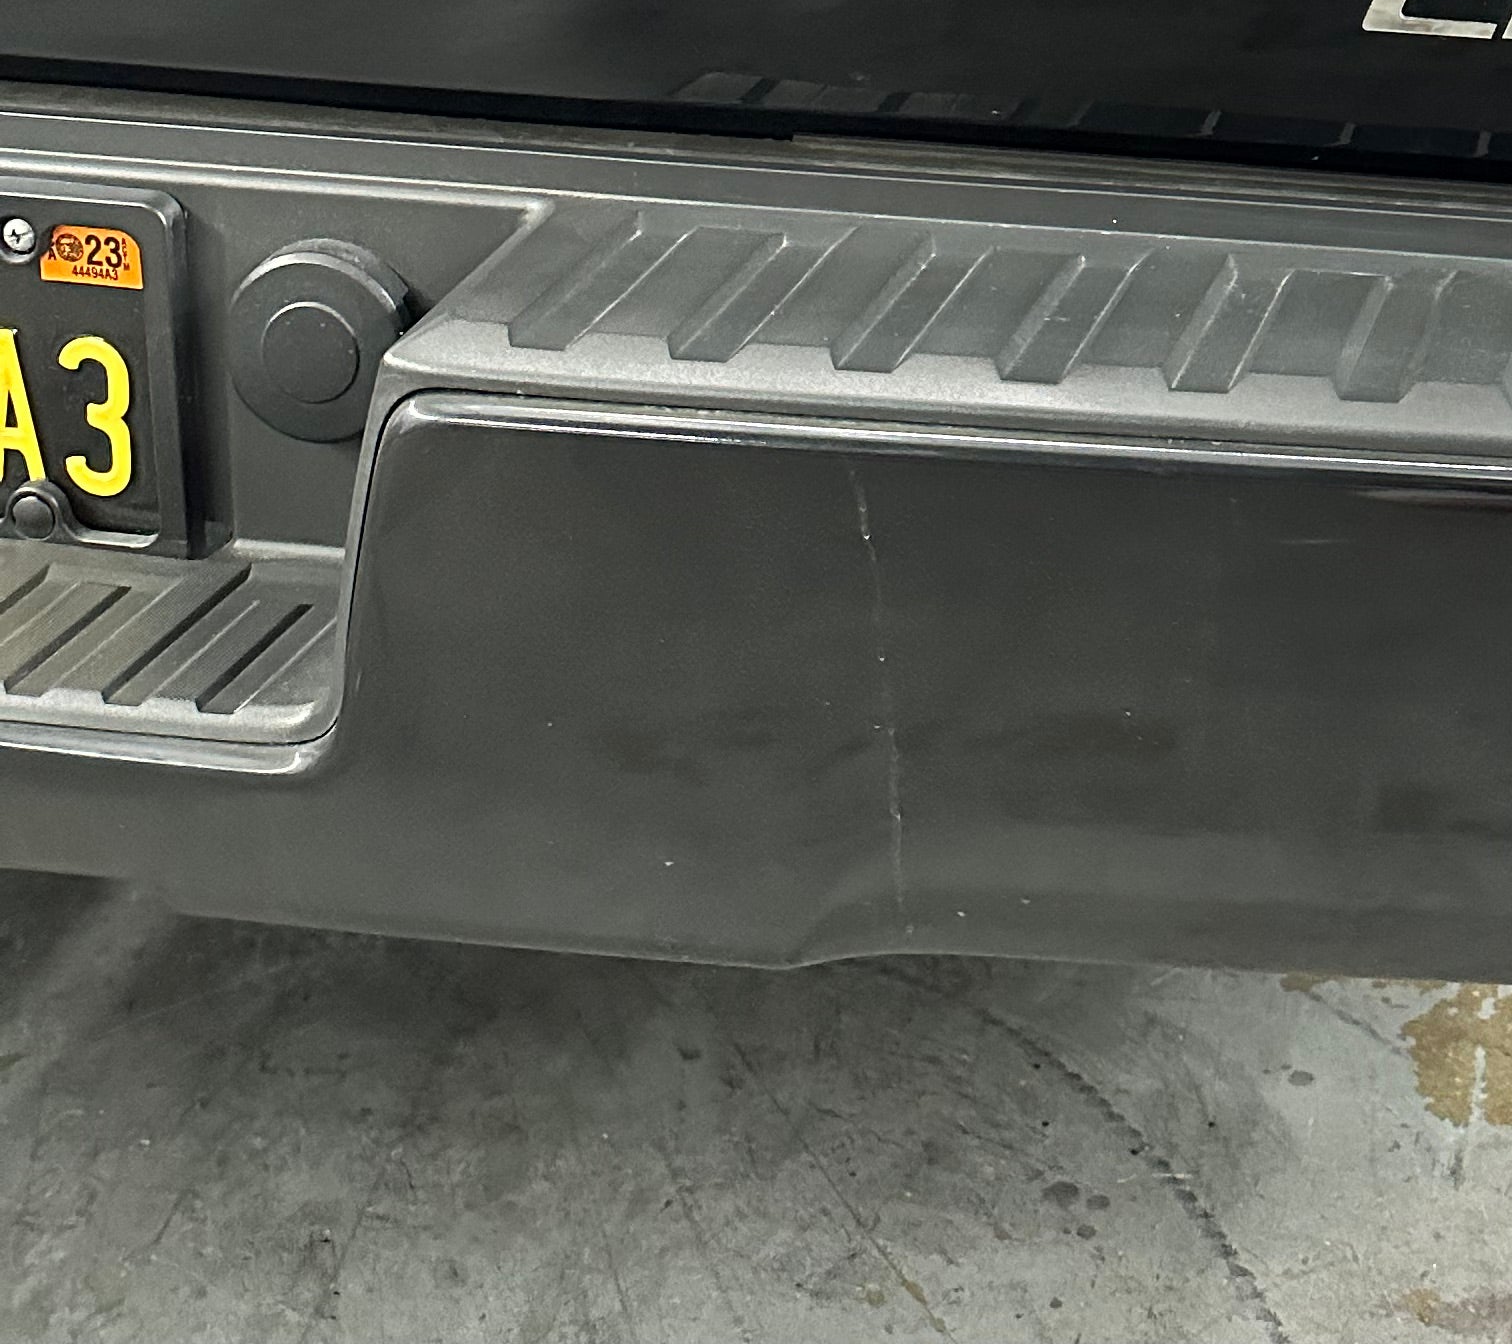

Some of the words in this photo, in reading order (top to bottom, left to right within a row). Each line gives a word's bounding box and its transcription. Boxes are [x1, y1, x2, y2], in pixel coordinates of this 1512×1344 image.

[84, 234, 123, 268] 23
[71, 265, 119, 281] 44494A3
[0, 328, 132, 497] A3
